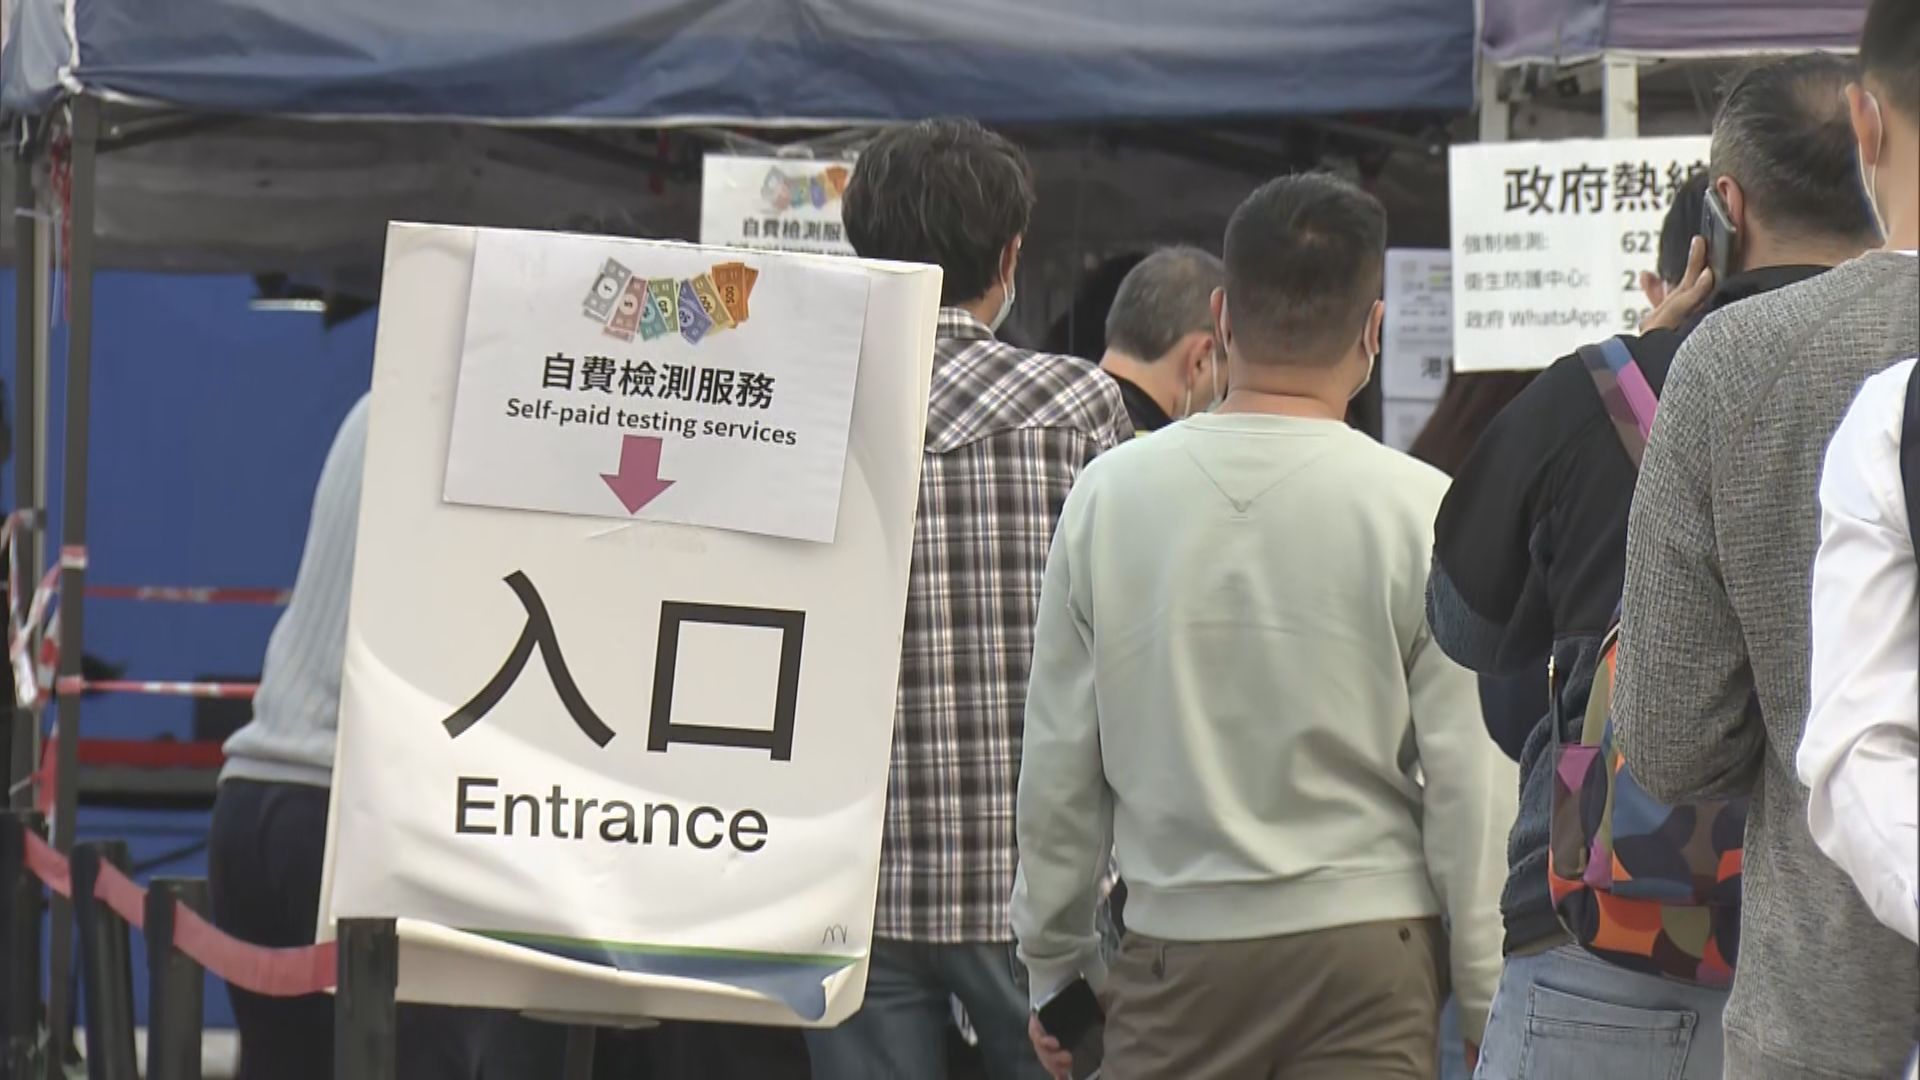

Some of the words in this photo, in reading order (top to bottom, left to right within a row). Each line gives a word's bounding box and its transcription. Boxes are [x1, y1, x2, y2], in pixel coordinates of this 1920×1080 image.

[743, 217, 850, 242] 自費檢測服
[1621, 270, 1645, 291] 2
[541, 352, 776, 409] 自費檢測服務
[506, 398, 610, 426] Self-paid
[617, 409, 697, 438] testing
[702, 419, 797, 446] services
[442, 569, 806, 762] 入口
[455, 776, 769, 853] Entrance
